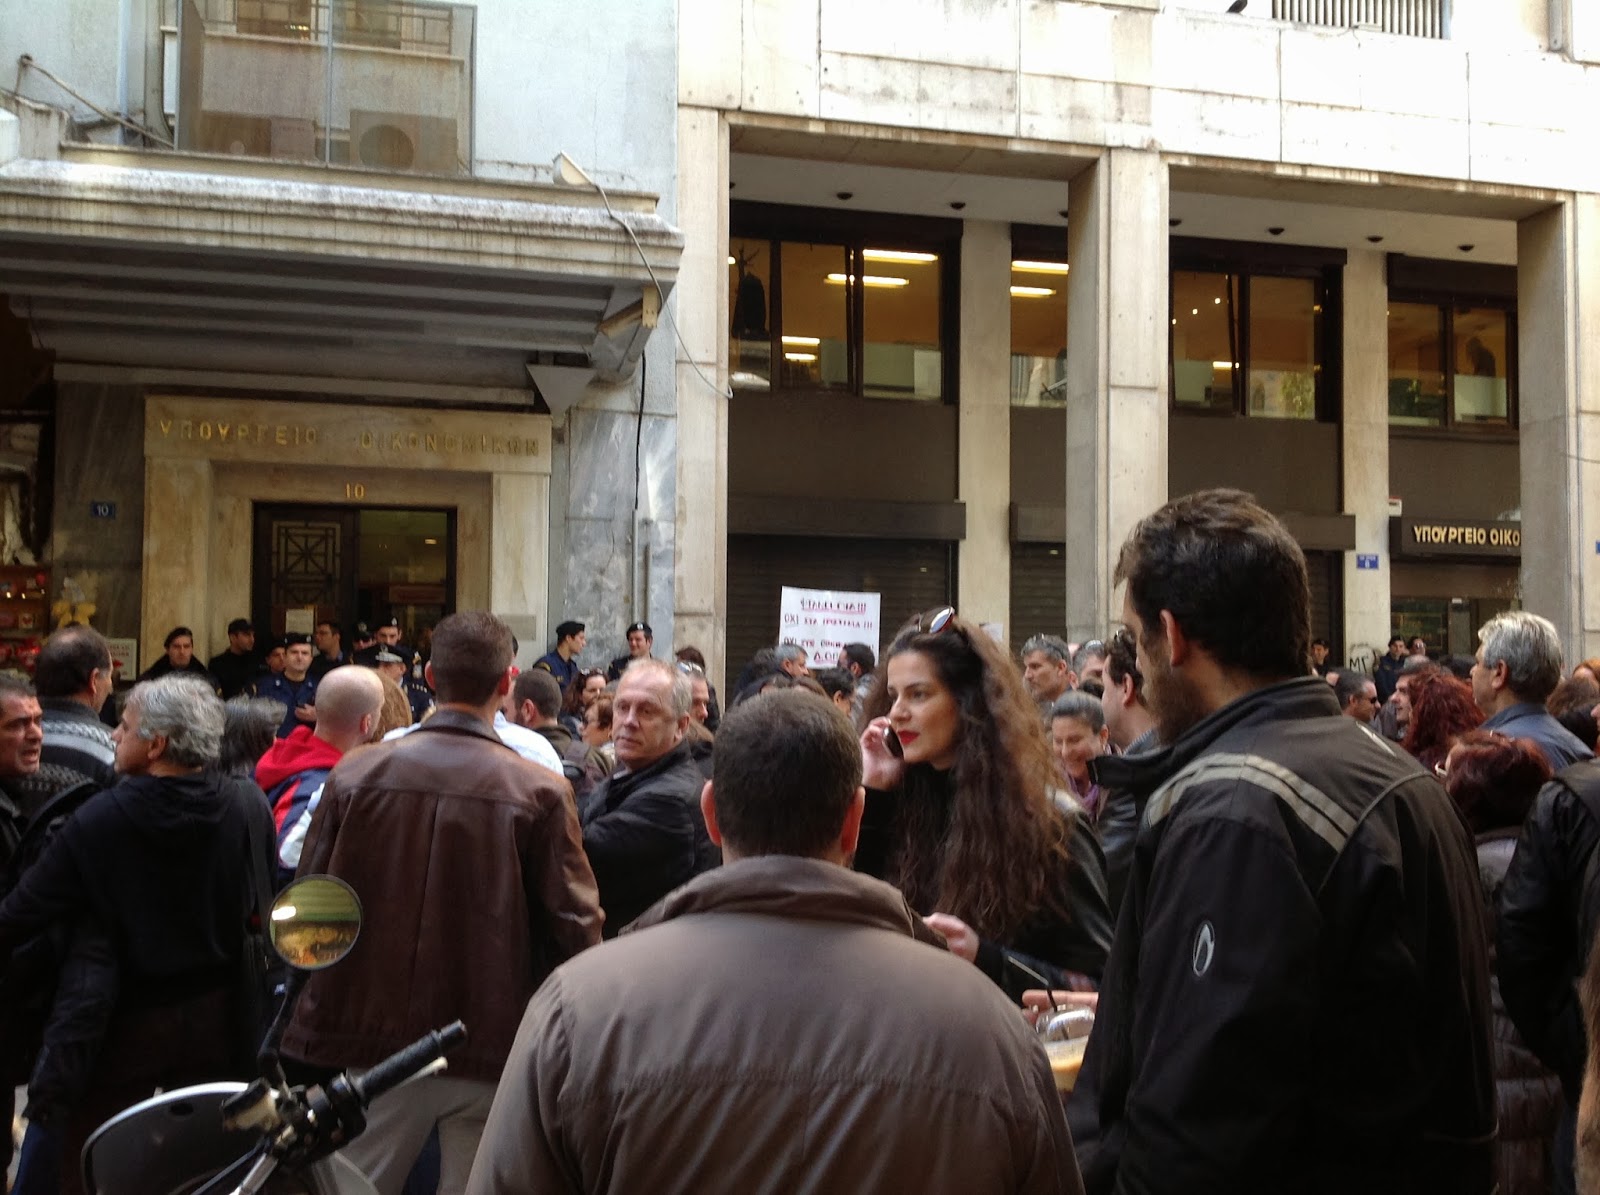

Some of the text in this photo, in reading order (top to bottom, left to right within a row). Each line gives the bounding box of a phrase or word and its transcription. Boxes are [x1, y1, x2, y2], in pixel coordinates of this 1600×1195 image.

[160, 419, 318, 445] ΥΠΟΥΡΓΕΙΟ
[345, 482, 365, 500] 10
[97, 503, 109, 517] 10
[1413, 525, 1487, 546] ΥΠΟΥΡΓΕΙΟ
